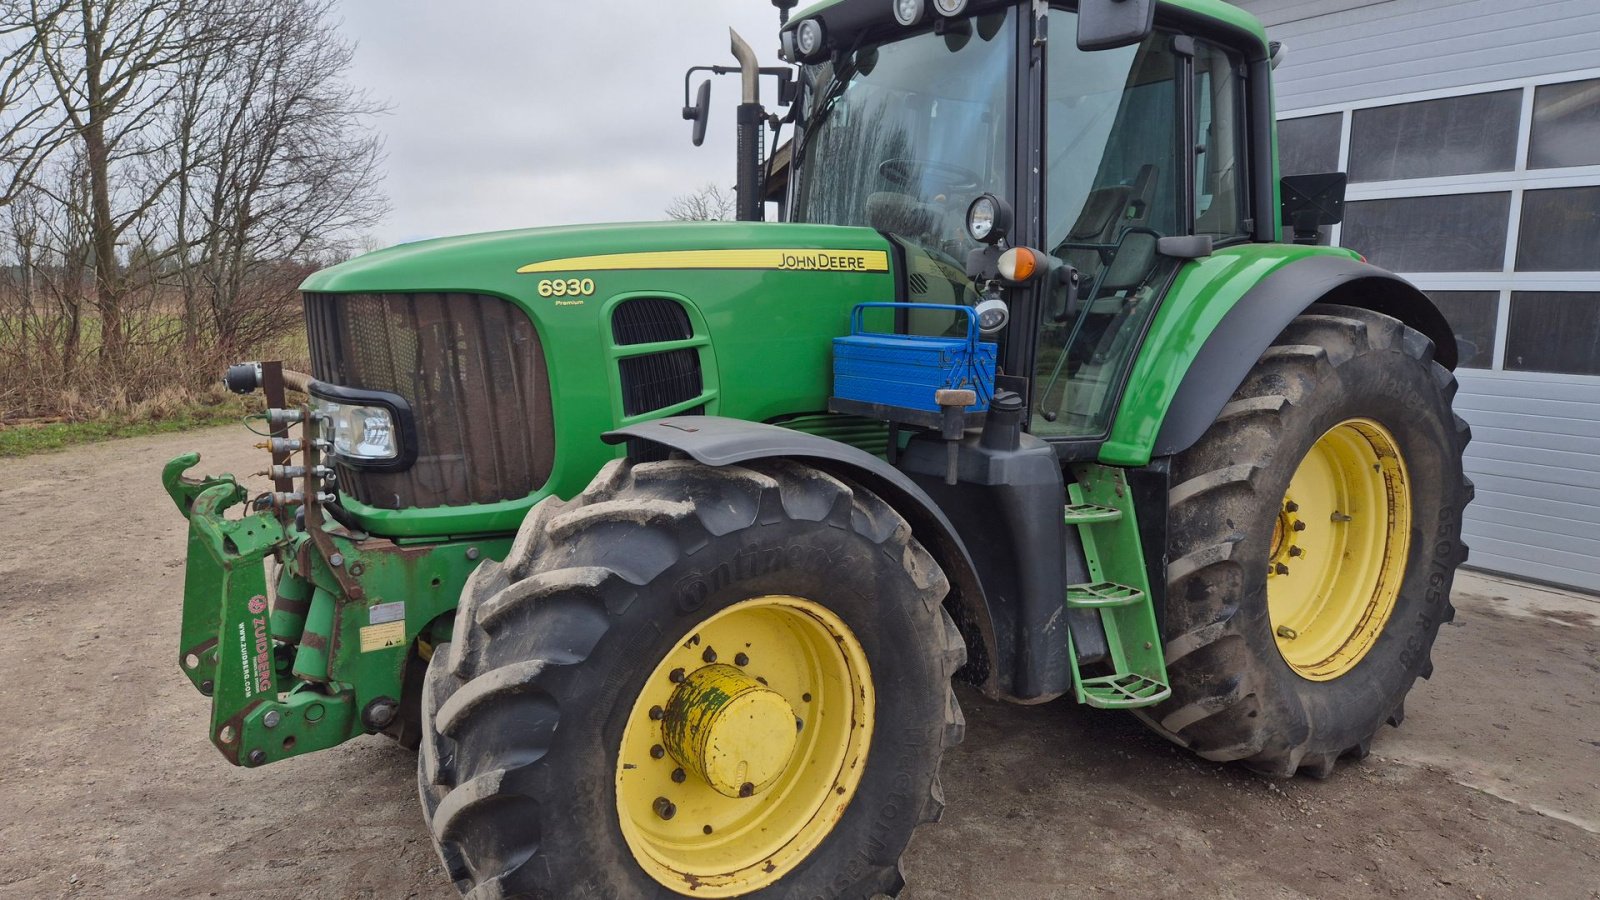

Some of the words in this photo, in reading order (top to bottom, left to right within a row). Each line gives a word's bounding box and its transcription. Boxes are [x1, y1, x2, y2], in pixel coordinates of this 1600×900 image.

[778, 253, 817, 270] JOHN
[818, 253, 866, 270] DEERE
[537, 277, 597, 298] 6930
[555, 299, 584, 307] Premium
[1424, 504, 1454, 606] 650/65
[1415, 610, 1434, 633] R
[252, 616, 272, 693] ZUIDBERG
